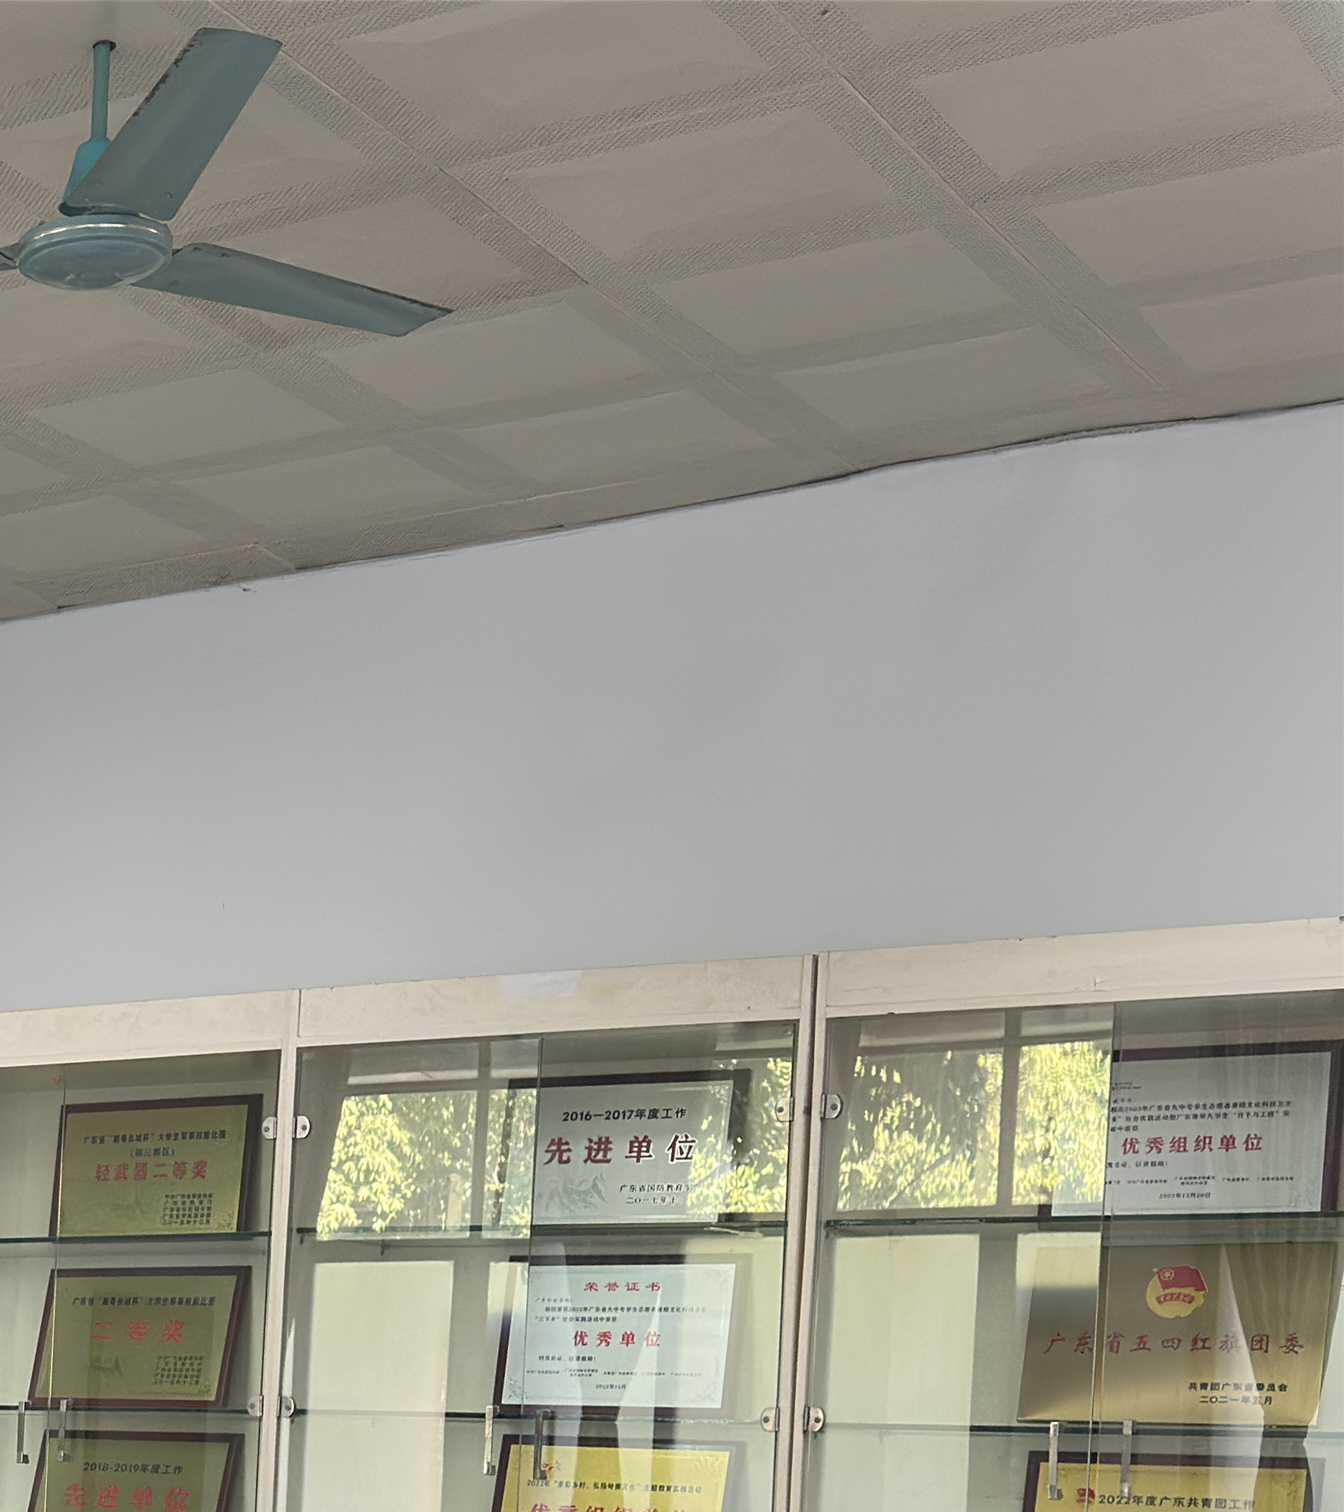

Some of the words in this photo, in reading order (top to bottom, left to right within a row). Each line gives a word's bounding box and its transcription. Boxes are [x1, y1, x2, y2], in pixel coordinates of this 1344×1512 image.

[543, 1133, 698, 1167] 先进单位
[1120, 1133, 1264, 1156] 优秀组织单位
[95, 1160, 210, 1183] 轻武器二等奖
[583, 1281, 662, 1293] 荣誉证书
[91, 1319, 186, 1344] 二等奖
[573, 1330, 661, 1348] 优秀单位
[1043, 1331, 1306, 1355] 广东省五四红旗团委
[82, 1461, 184, 1475] 2018-2019年度工作
[1098, 1493, 1256, 1512] 2022年度广东共青团工作
